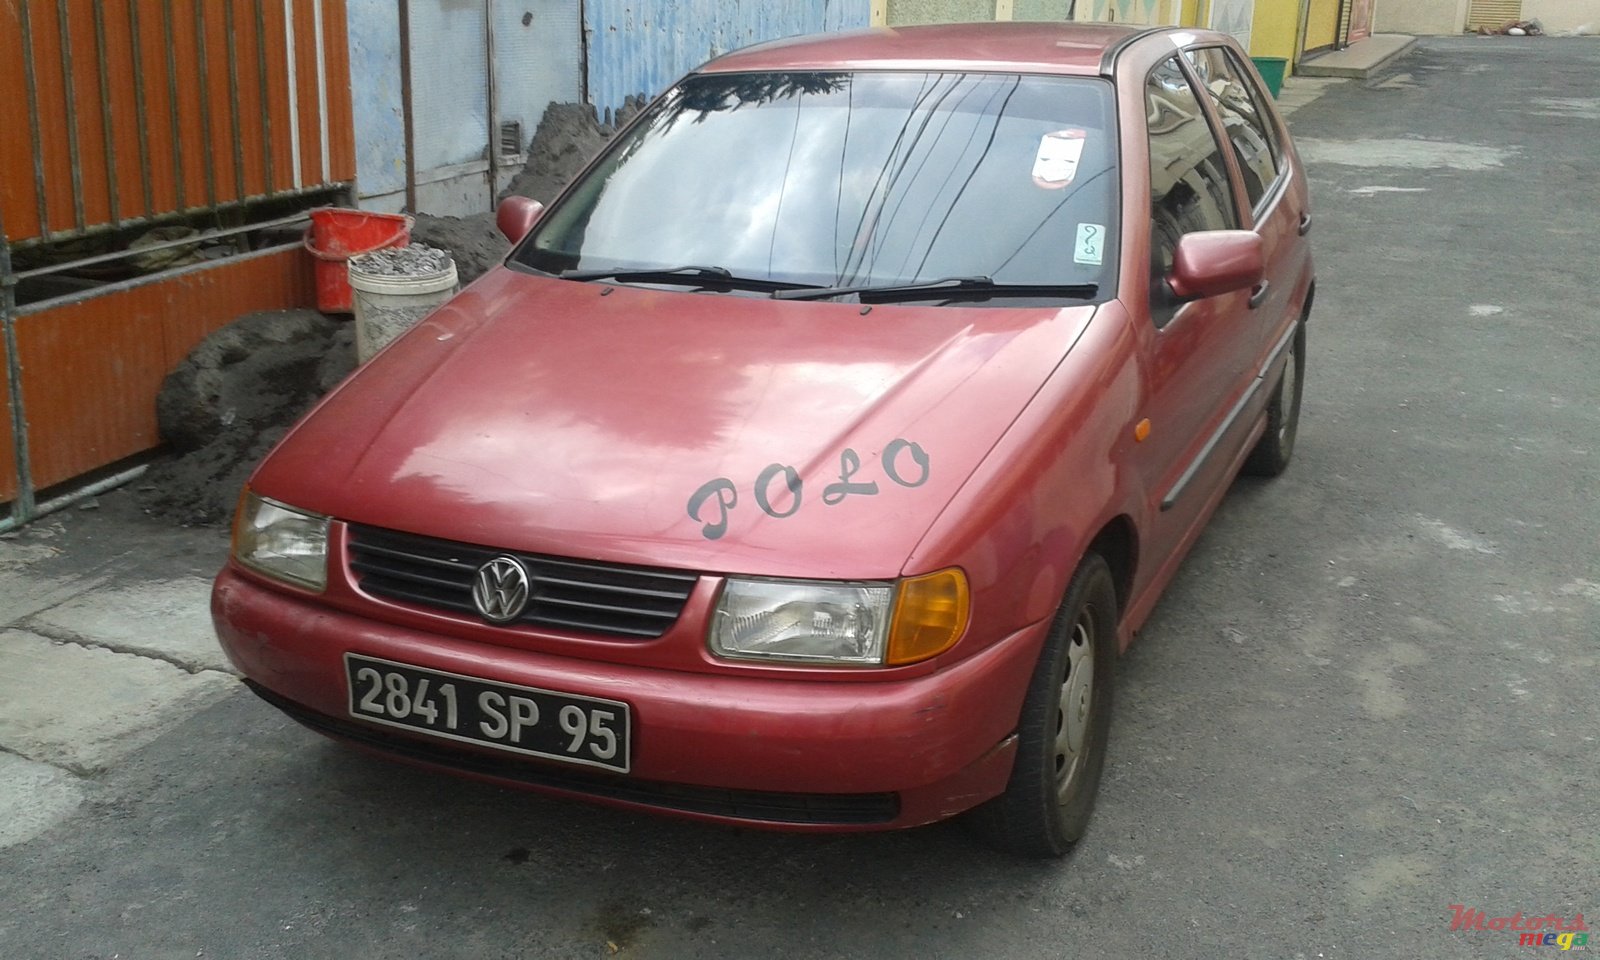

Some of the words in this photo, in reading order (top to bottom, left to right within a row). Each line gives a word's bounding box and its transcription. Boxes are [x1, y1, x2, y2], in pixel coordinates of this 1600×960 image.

[687, 438, 930, 540] POLO
[357, 667, 458, 730] 2841
[478, 691, 540, 743] SP
[558, 705, 617, 760] 95
